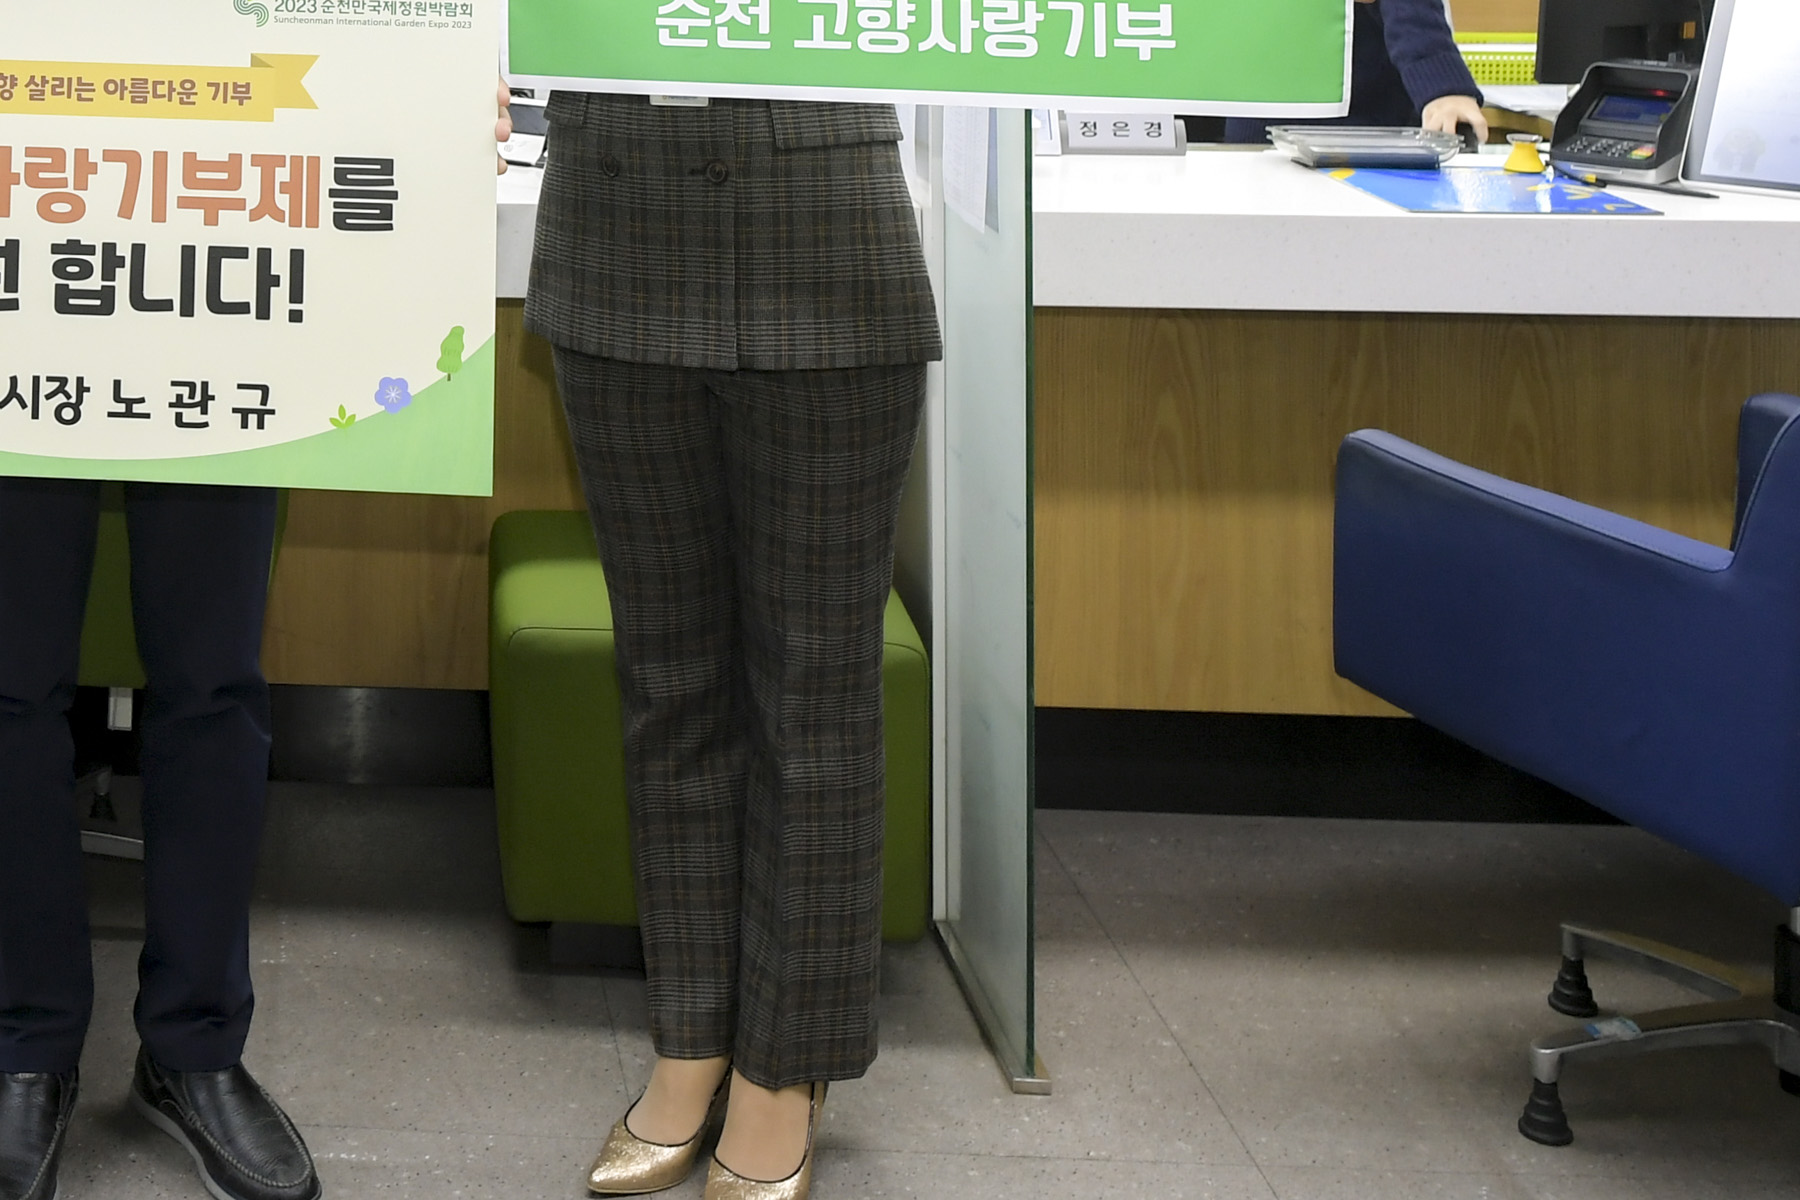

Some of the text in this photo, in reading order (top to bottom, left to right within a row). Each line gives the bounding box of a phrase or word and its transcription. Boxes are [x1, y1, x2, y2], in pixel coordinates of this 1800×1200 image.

[274, 15, 472, 30] Suncheonman International Garden Expo 2023
[24, 72, 96, 106] 살리는
[102, 77, 199, 108] 아름다운
[205, 81, 252, 109] 기부
[51, 238, 305, 324] 합니다!
